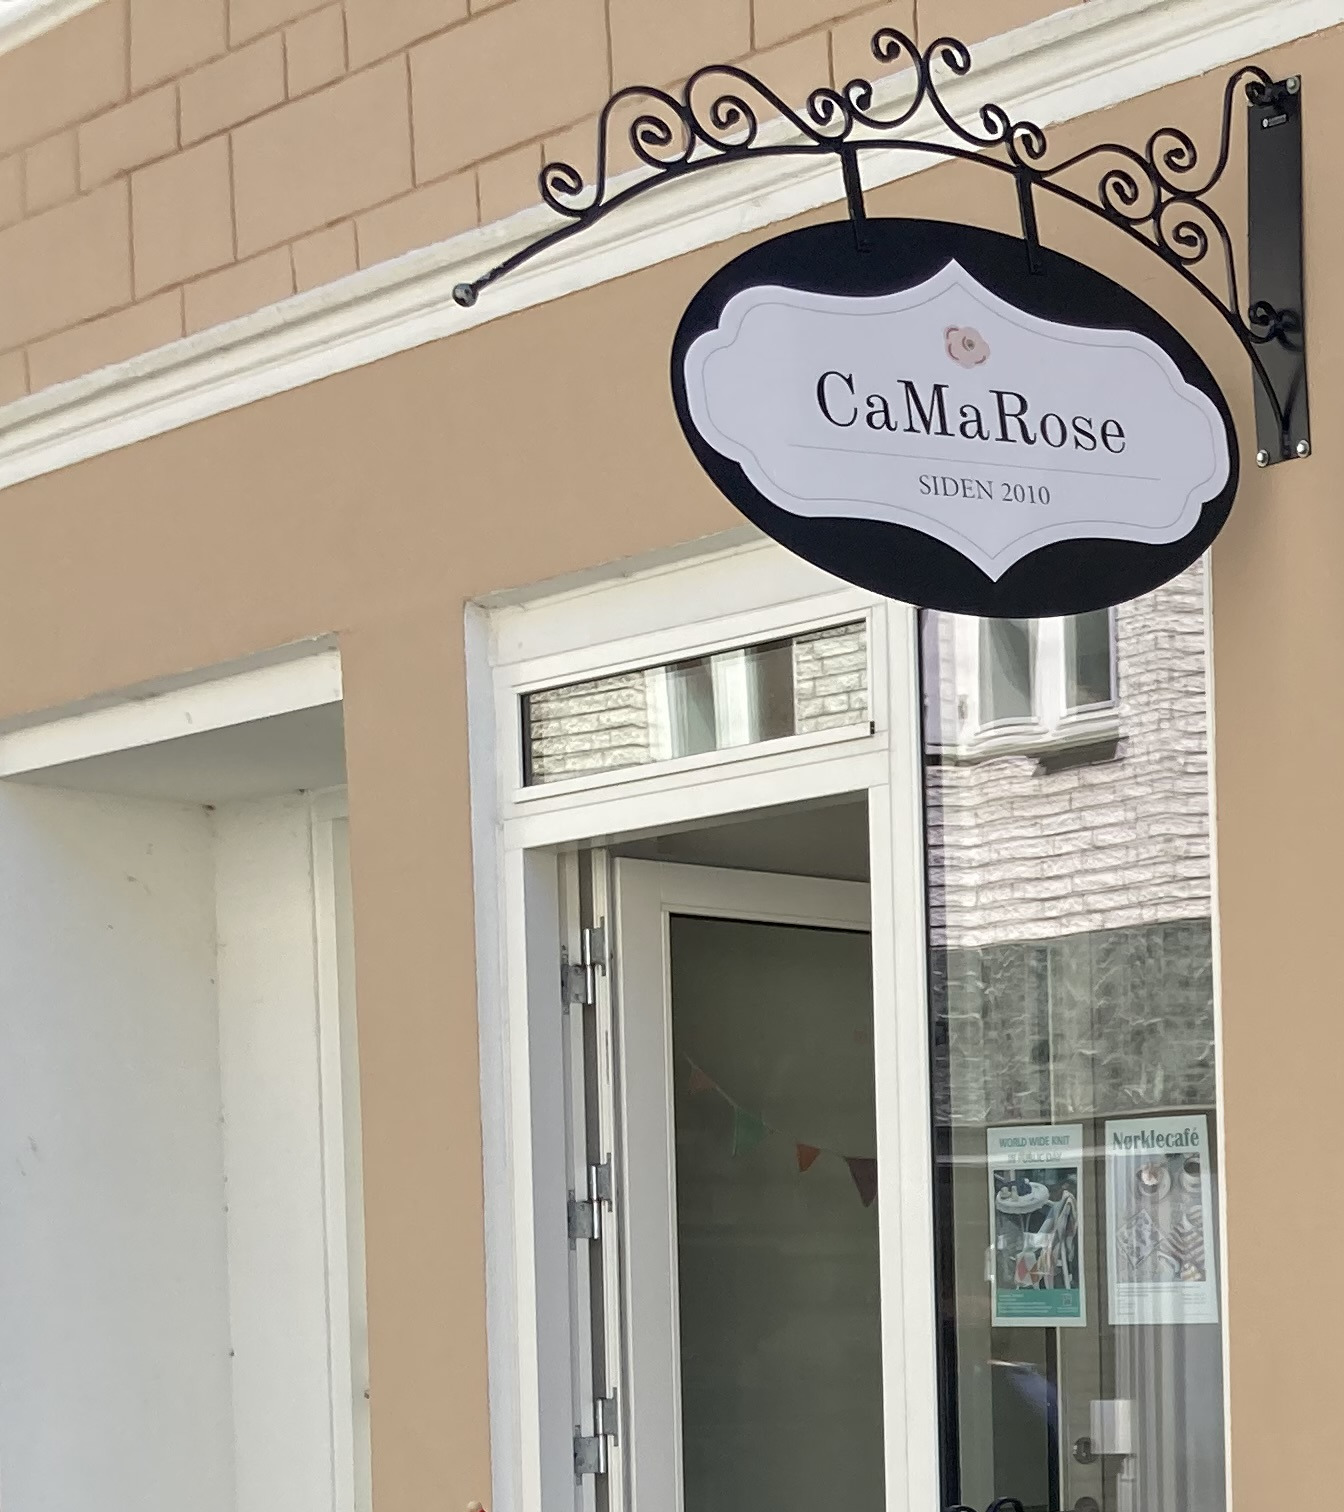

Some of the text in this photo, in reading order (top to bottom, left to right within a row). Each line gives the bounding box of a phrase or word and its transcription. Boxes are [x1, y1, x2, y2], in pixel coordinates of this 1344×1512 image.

[815, 369, 1127, 454] CaMaRose
[918, 473, 1052, 506] SIDEN 2010
[999, 1135, 1071, 1147] WORLD WIDE KNIT
[1112, 1127, 1200, 1150] Nørklecafé
